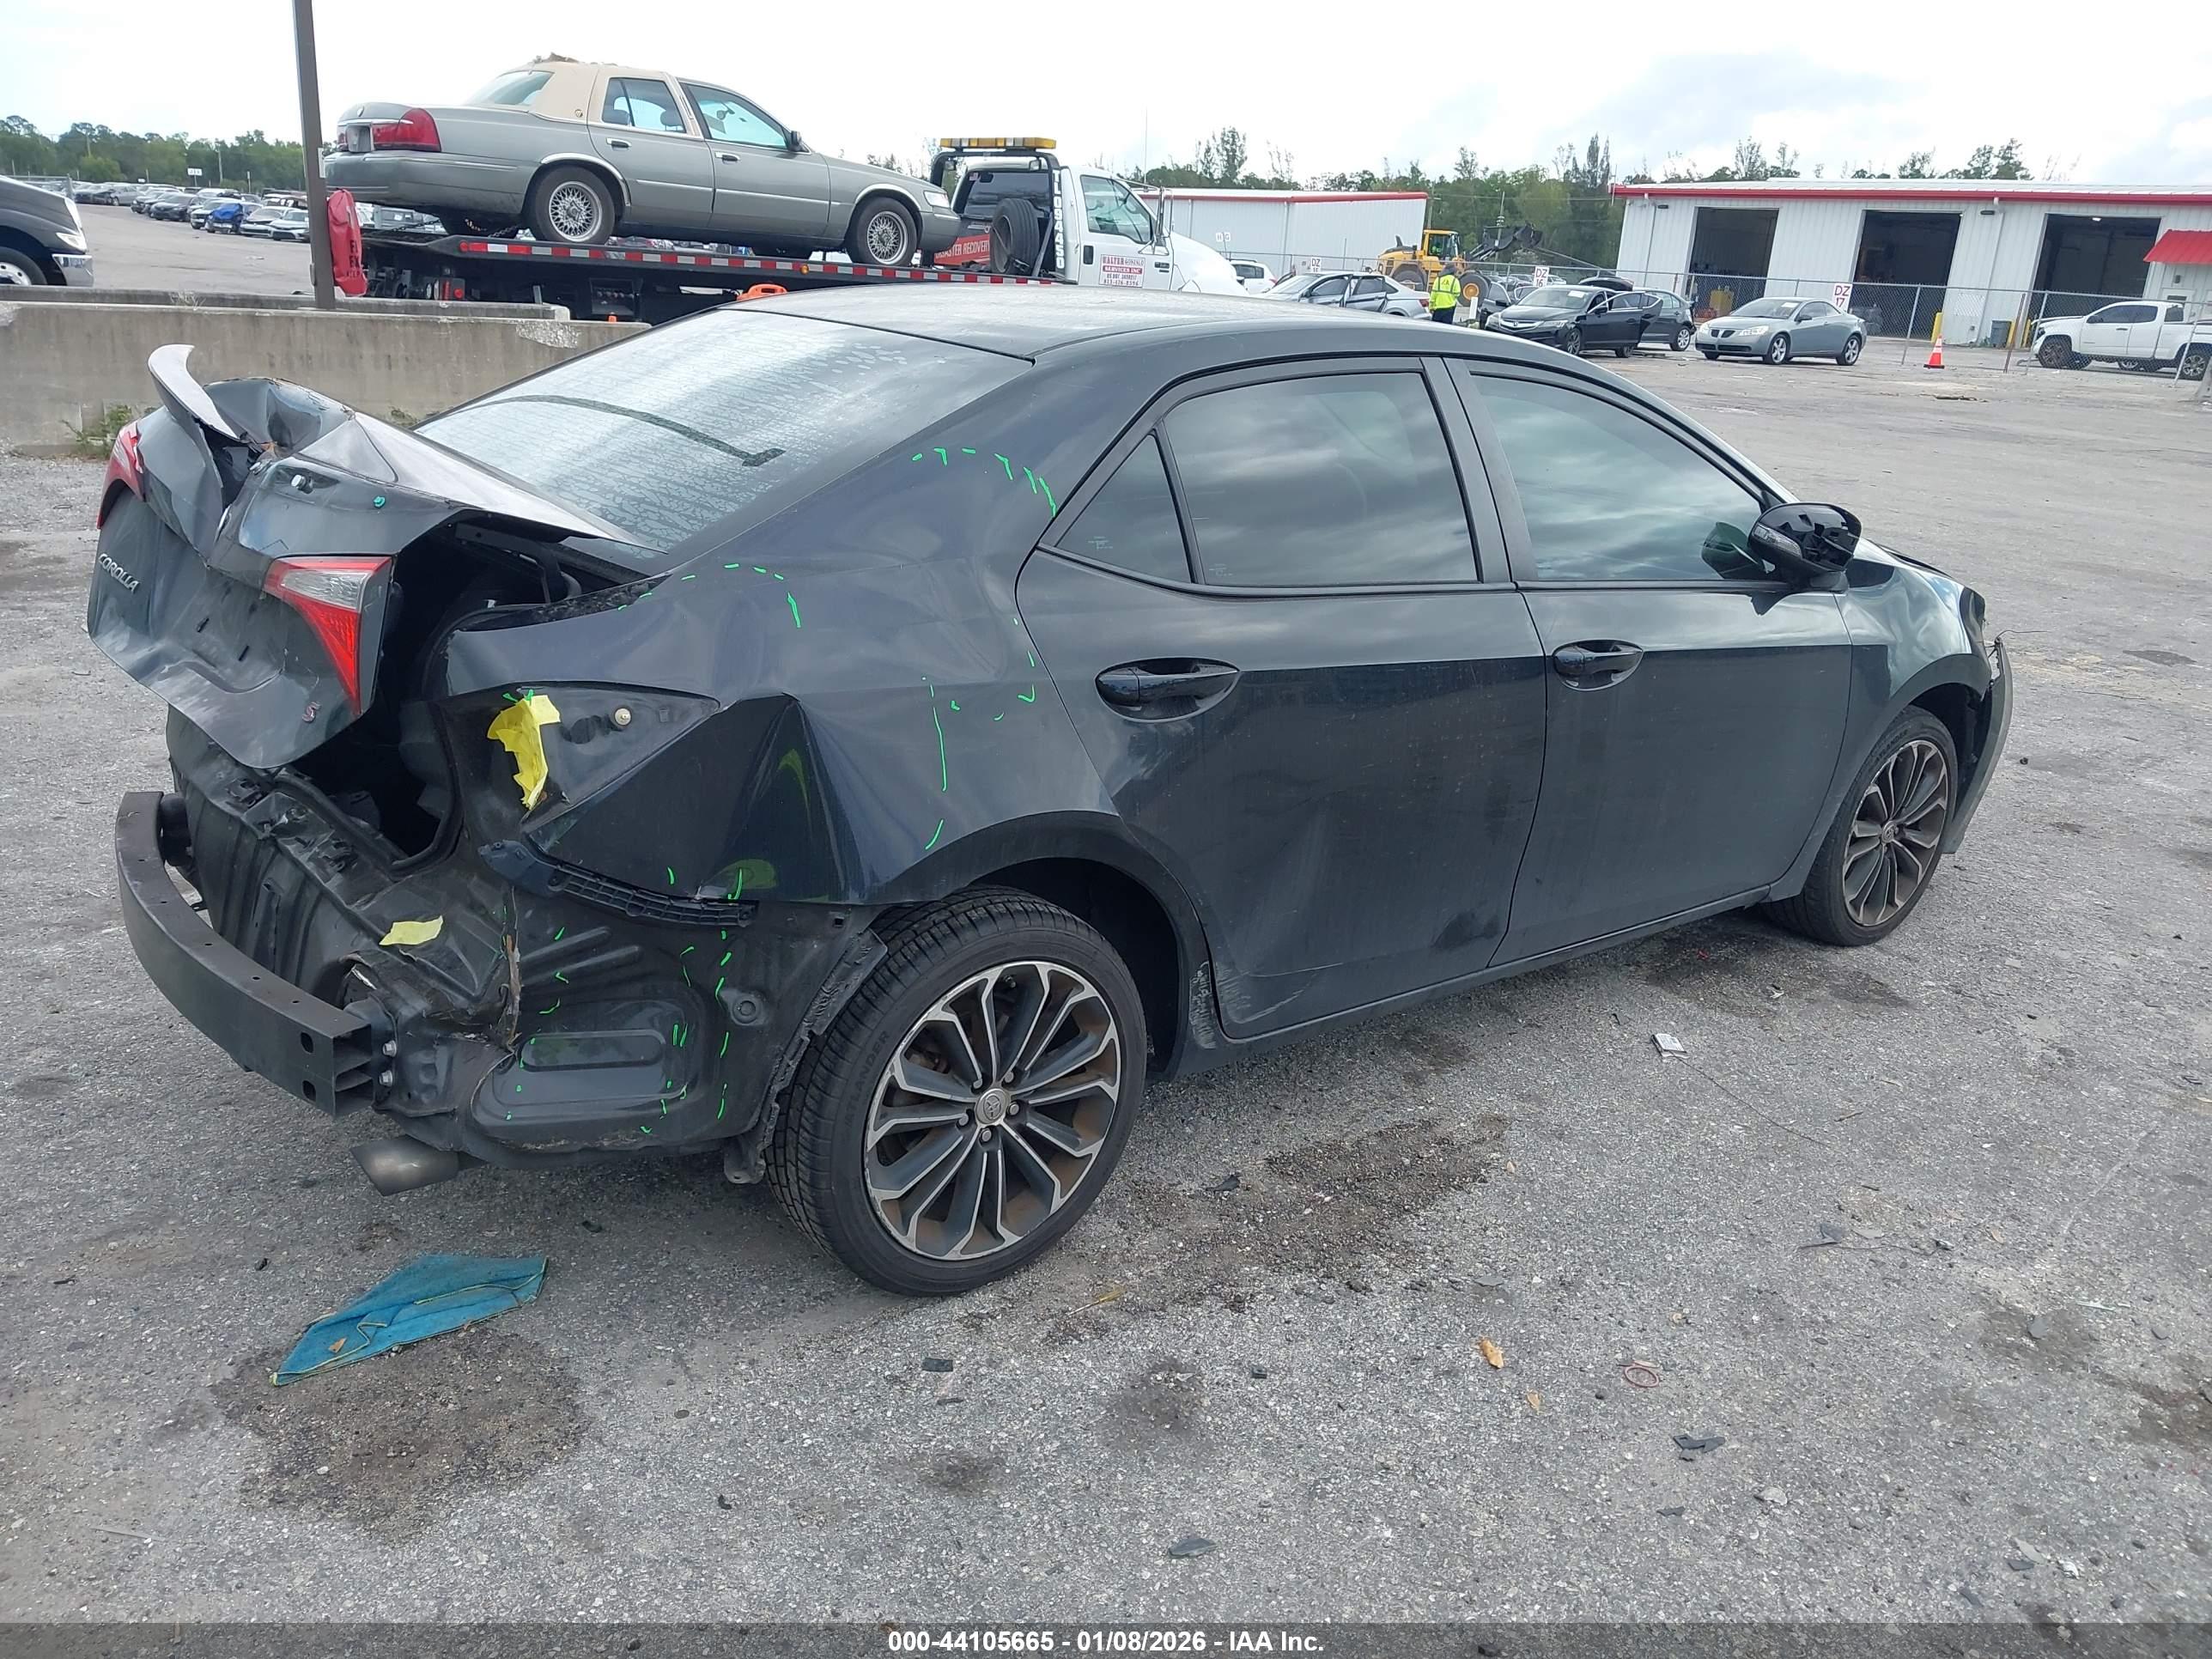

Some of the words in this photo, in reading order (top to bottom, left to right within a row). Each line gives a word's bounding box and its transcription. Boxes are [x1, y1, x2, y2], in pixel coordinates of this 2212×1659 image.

[1103, 257, 1124, 265] WALTER
[1311, 258, 1321, 267] DZ
[1535, 268, 1547, 278] DZ
[1536, 278, 1543, 287] 16
[1834, 285, 1850, 296] DZ
[1836, 297, 1845, 307] 17
[99, 553, 139, 592] COROLLA
